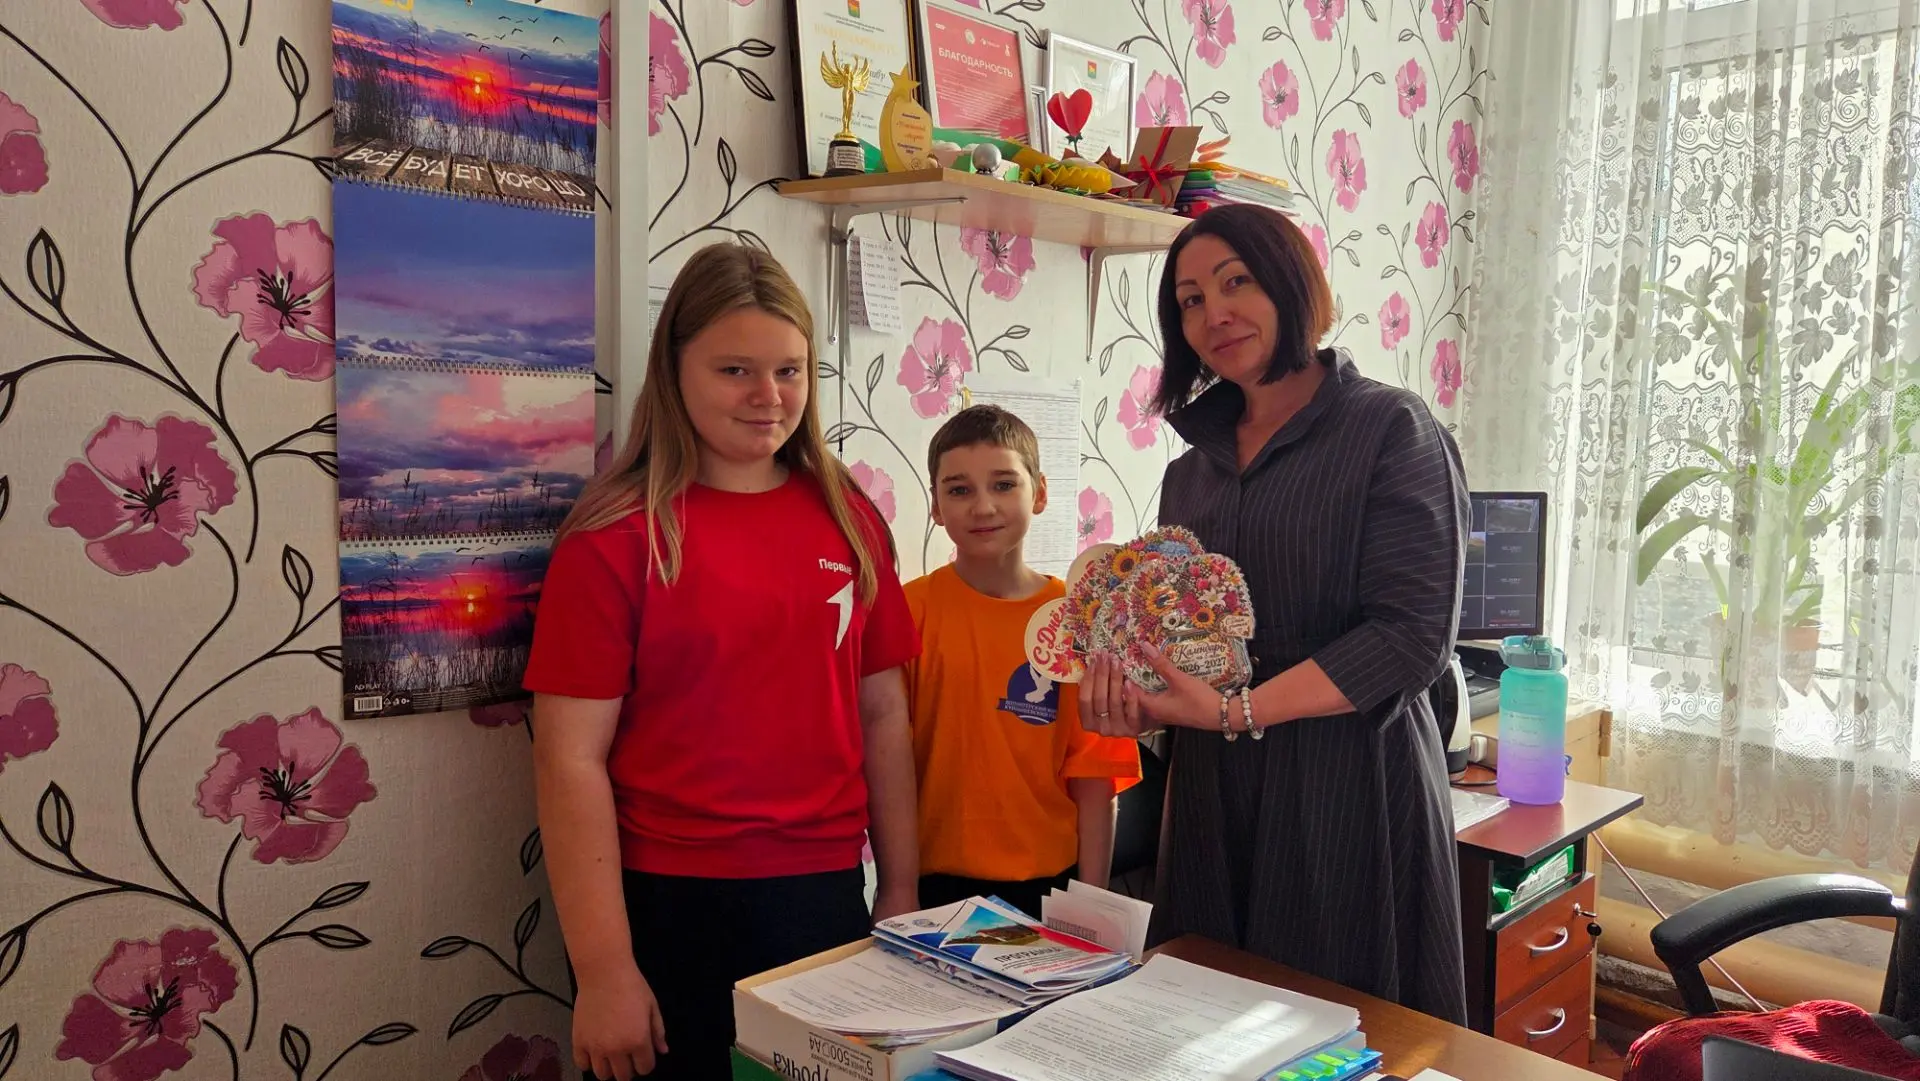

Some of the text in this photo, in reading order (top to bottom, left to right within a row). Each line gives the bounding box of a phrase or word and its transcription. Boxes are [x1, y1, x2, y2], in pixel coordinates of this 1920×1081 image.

[938, 47, 1014, 78] БЛАГОДАРНОСТЬ
[344, 147, 587, 198] ВСЁ БУДЕТ ХОРОШО
[1032, 645, 1050, 665] С
[808, 1036, 821, 1053] А4
[830, 1044, 850, 1067] 500
[866, 1060, 874, 1076] 5
